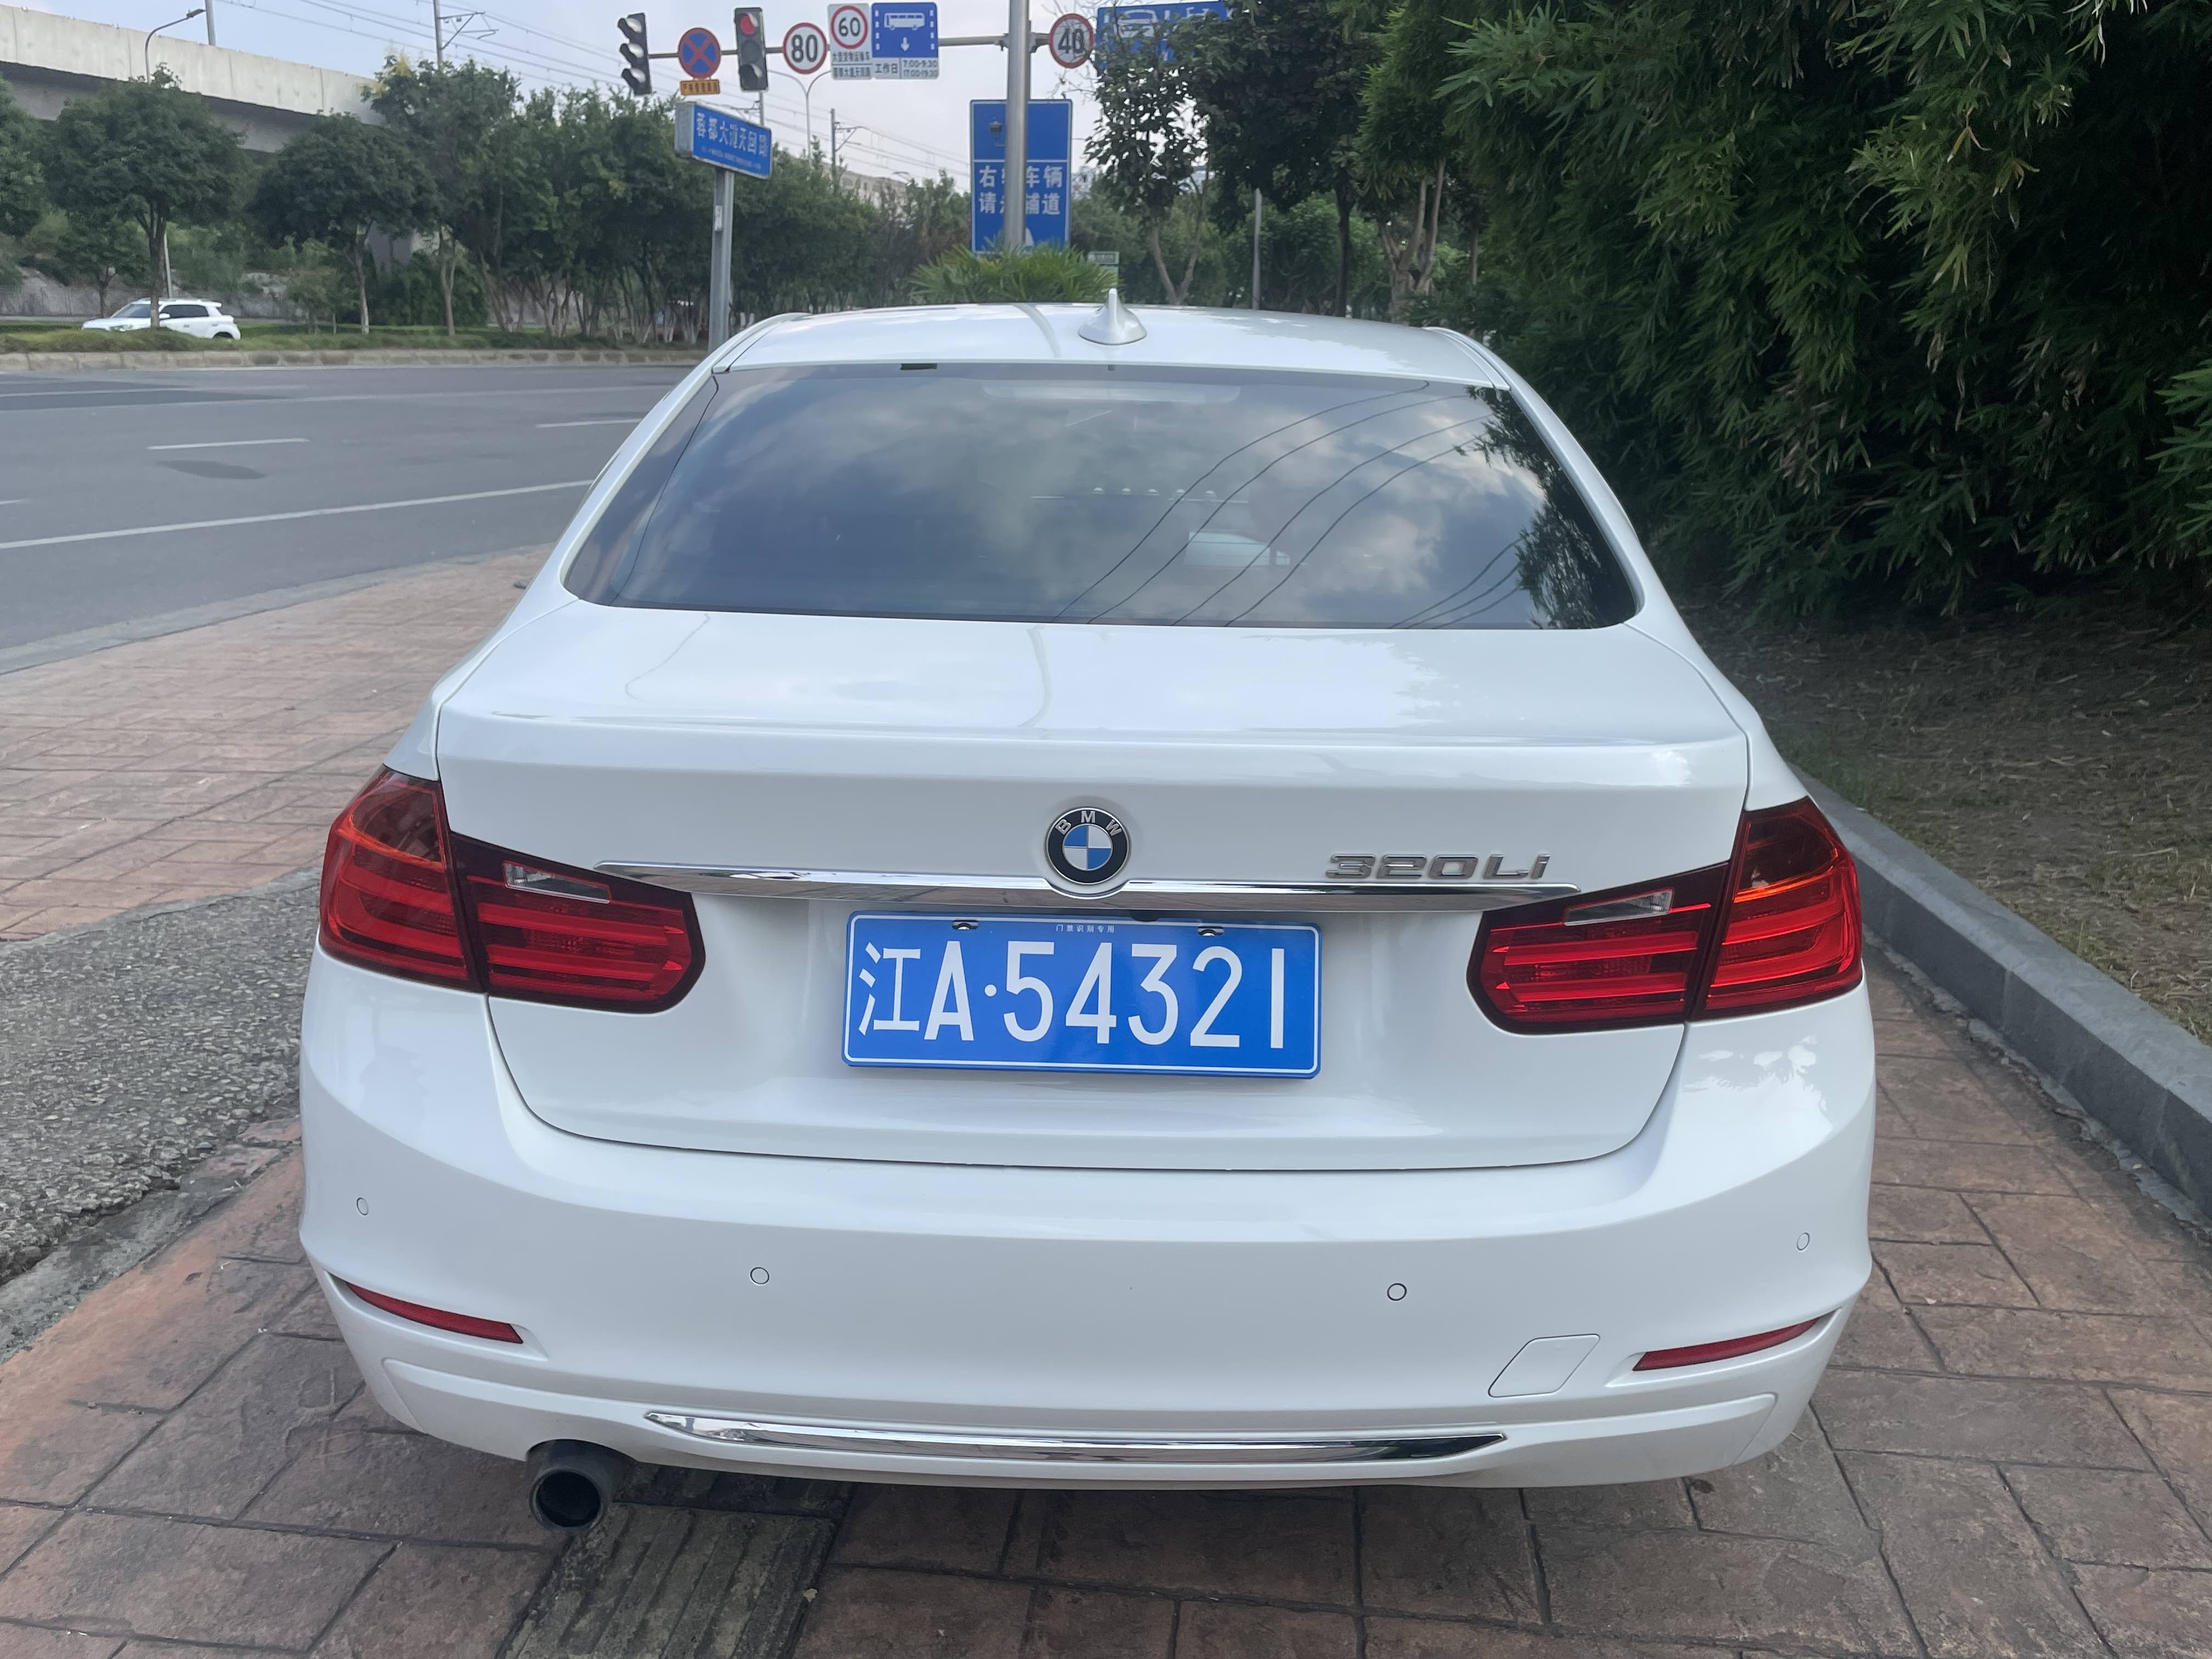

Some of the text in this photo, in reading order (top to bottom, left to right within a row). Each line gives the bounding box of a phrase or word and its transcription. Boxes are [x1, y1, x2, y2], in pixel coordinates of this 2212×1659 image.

[839, 17, 861, 37] 60
[791, 34, 818, 63] 80
[1058, 27, 1085, 54] 40
[874, 63, 898, 74] 工作日
[979, 165, 1063, 188] 右车辆
[978, 191, 1060, 215] 请辅道
[1055, 810, 1122, 837] BMW
[1325, 854, 1551, 879] 320Li
[1056, 924, 1115, 933] 门禁识别专用
[858, 940, 1284, 1049] 江A·54321
